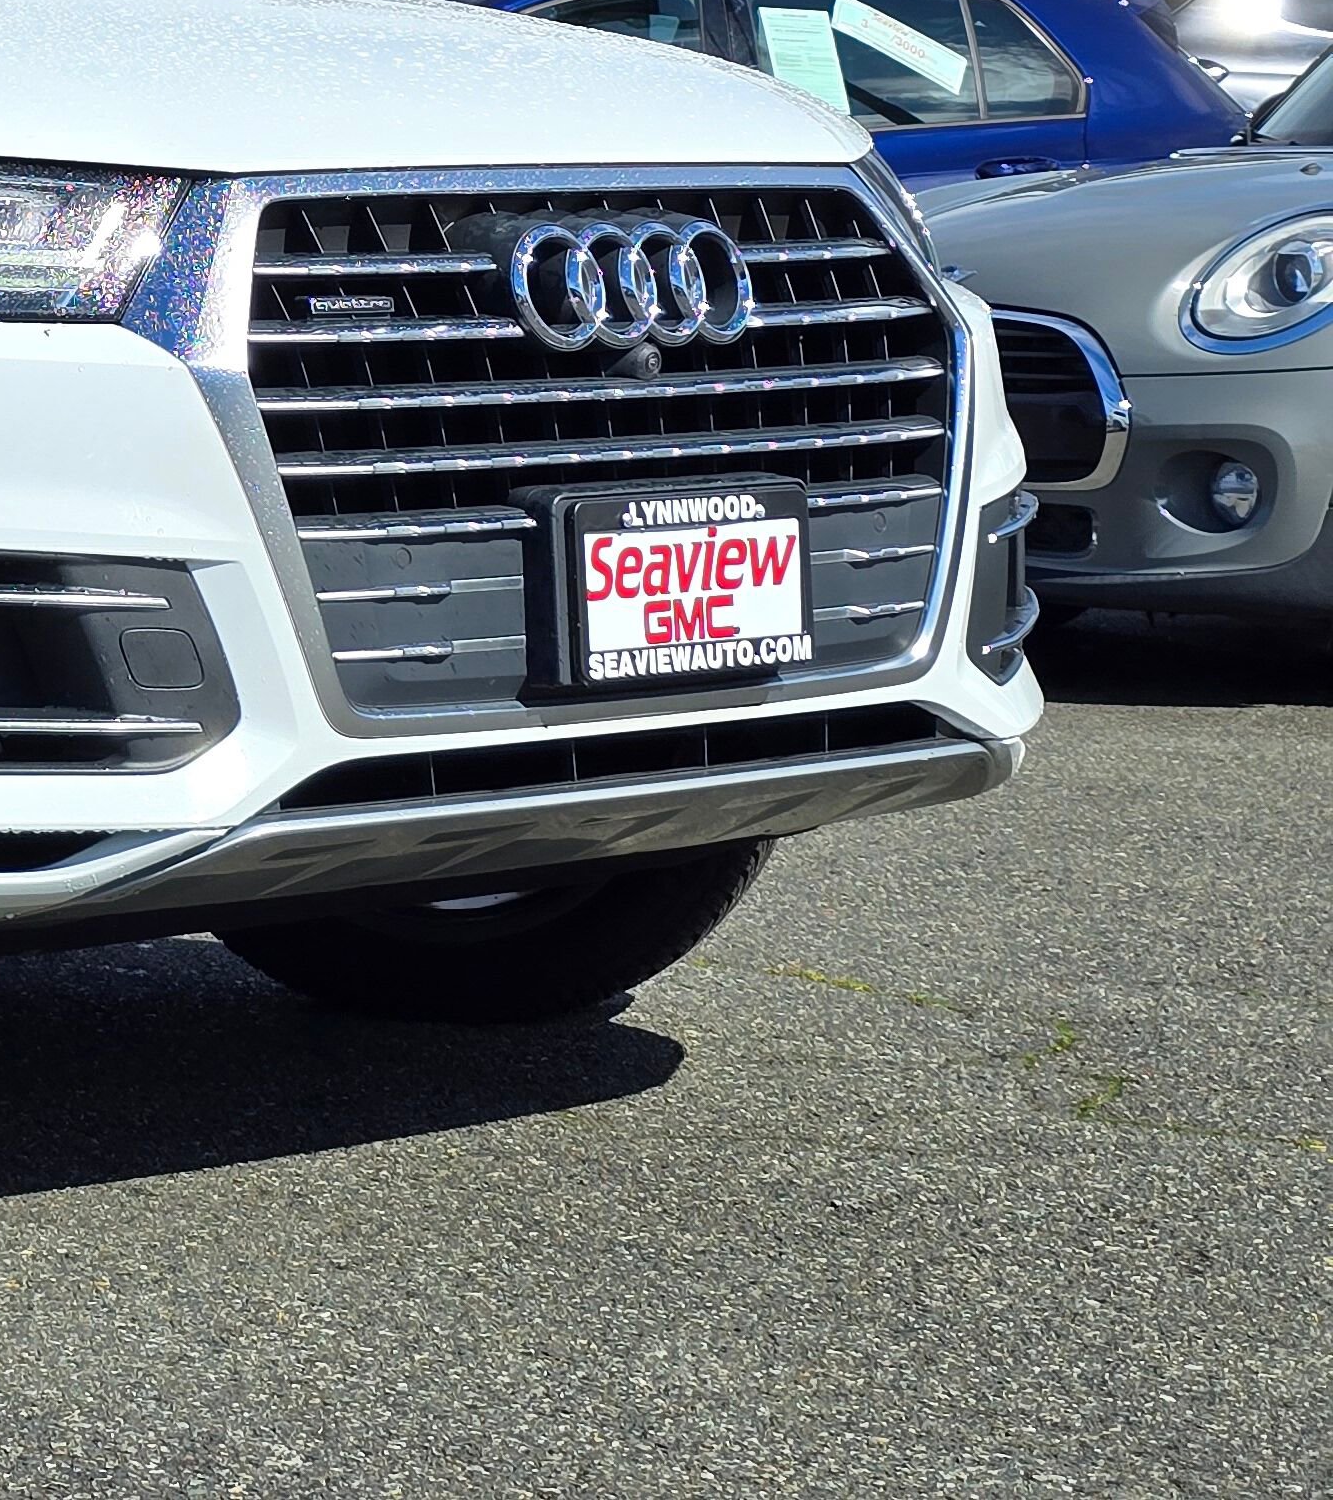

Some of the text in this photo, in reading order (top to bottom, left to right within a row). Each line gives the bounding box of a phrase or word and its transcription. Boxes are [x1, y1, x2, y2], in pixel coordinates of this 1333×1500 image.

[628, 494, 756, 527] LYNNWOOD
[587, 525, 796, 601] Seaview
[643, 594, 740, 644] GMC
[588, 634, 813, 680] SEAVIEWAUTO.COM
